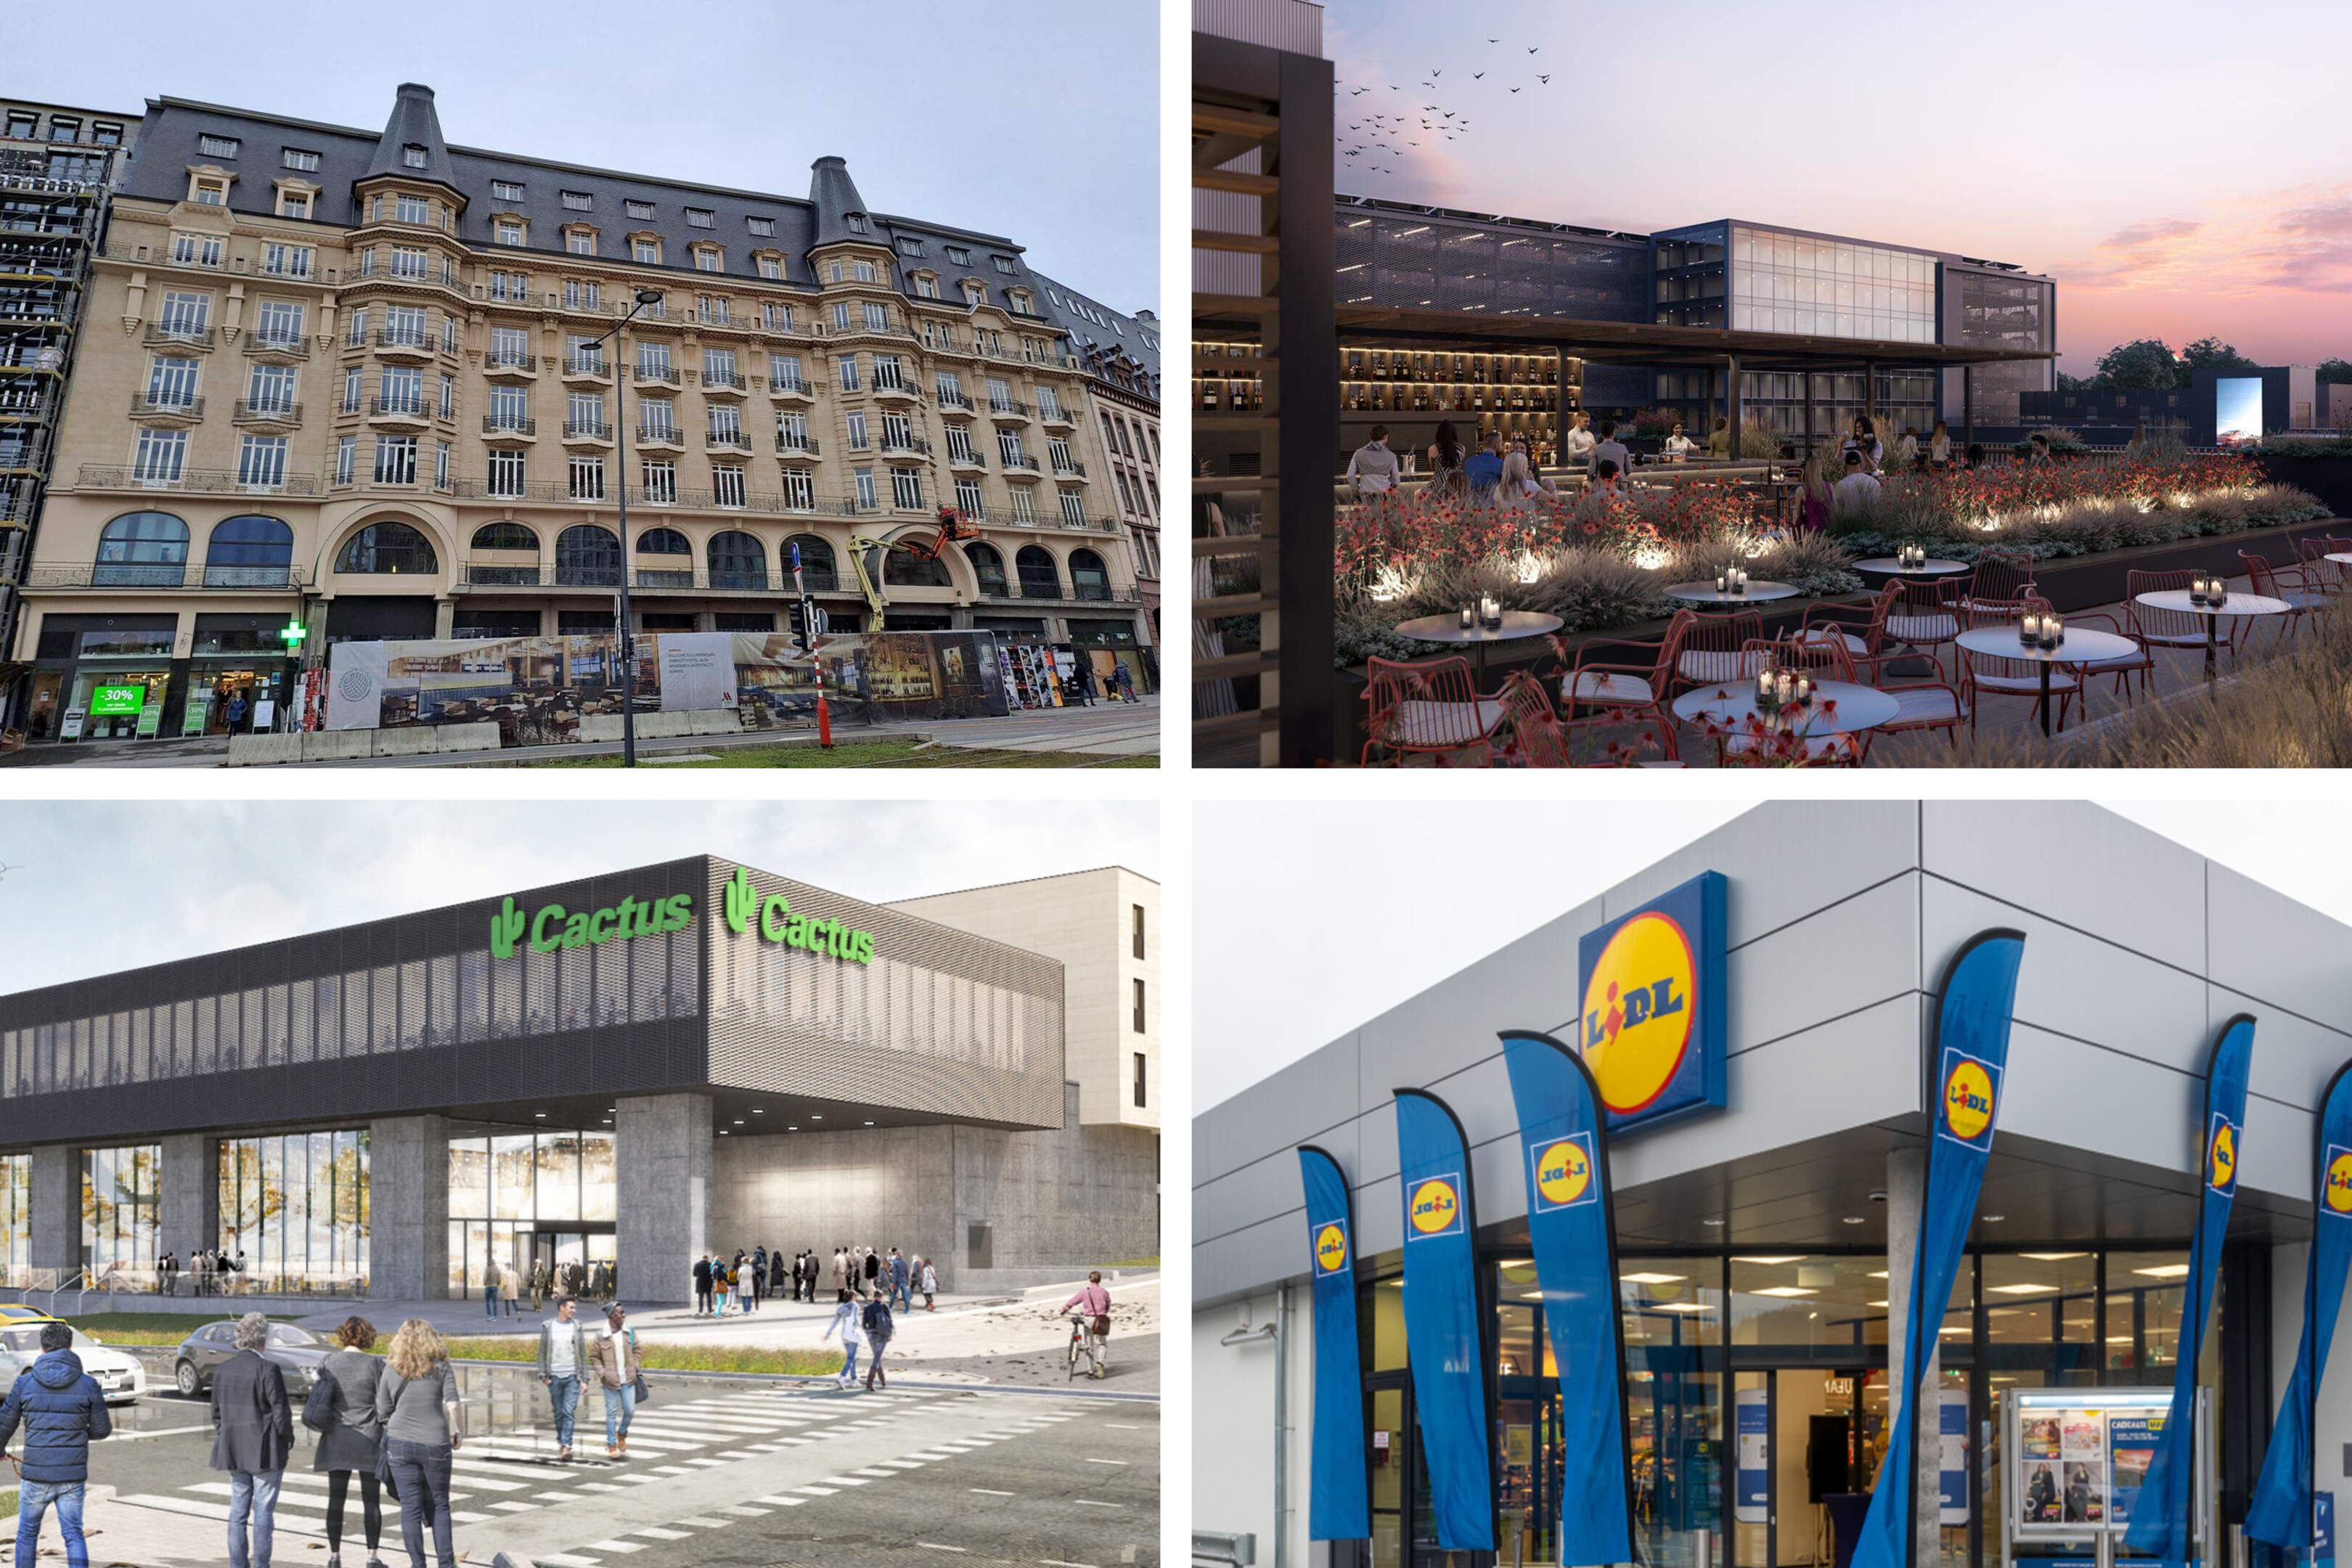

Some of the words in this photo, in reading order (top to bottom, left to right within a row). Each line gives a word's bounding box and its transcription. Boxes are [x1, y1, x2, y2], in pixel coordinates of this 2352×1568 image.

[100, 690, 134, 701] -30%
[531, 894, 692, 952] Cactus
[761, 894, 873, 964] Cactus
[2111, 1421, 2147, 1429] CADEAUX
